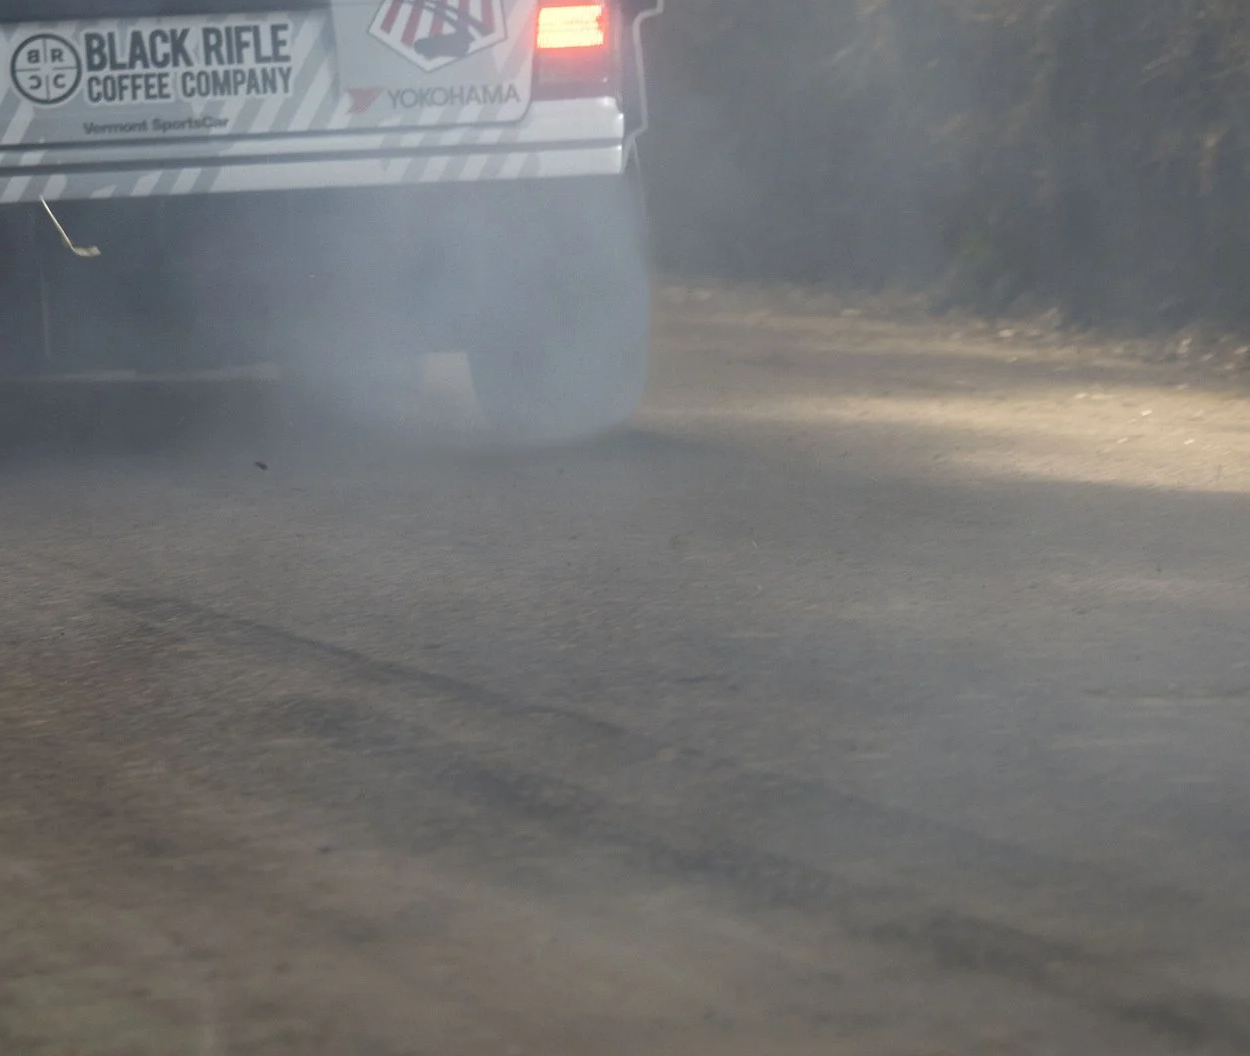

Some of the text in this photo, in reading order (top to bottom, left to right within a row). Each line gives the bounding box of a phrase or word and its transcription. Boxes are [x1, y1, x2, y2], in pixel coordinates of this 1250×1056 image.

[83, 23, 291, 72] BLACK RIFLE
[87, 67, 292, 103] COFFEE COMPANY
[387, 83, 521, 109] YOKOHAMA
[83, 116, 229, 135] Vermont SportsCar
